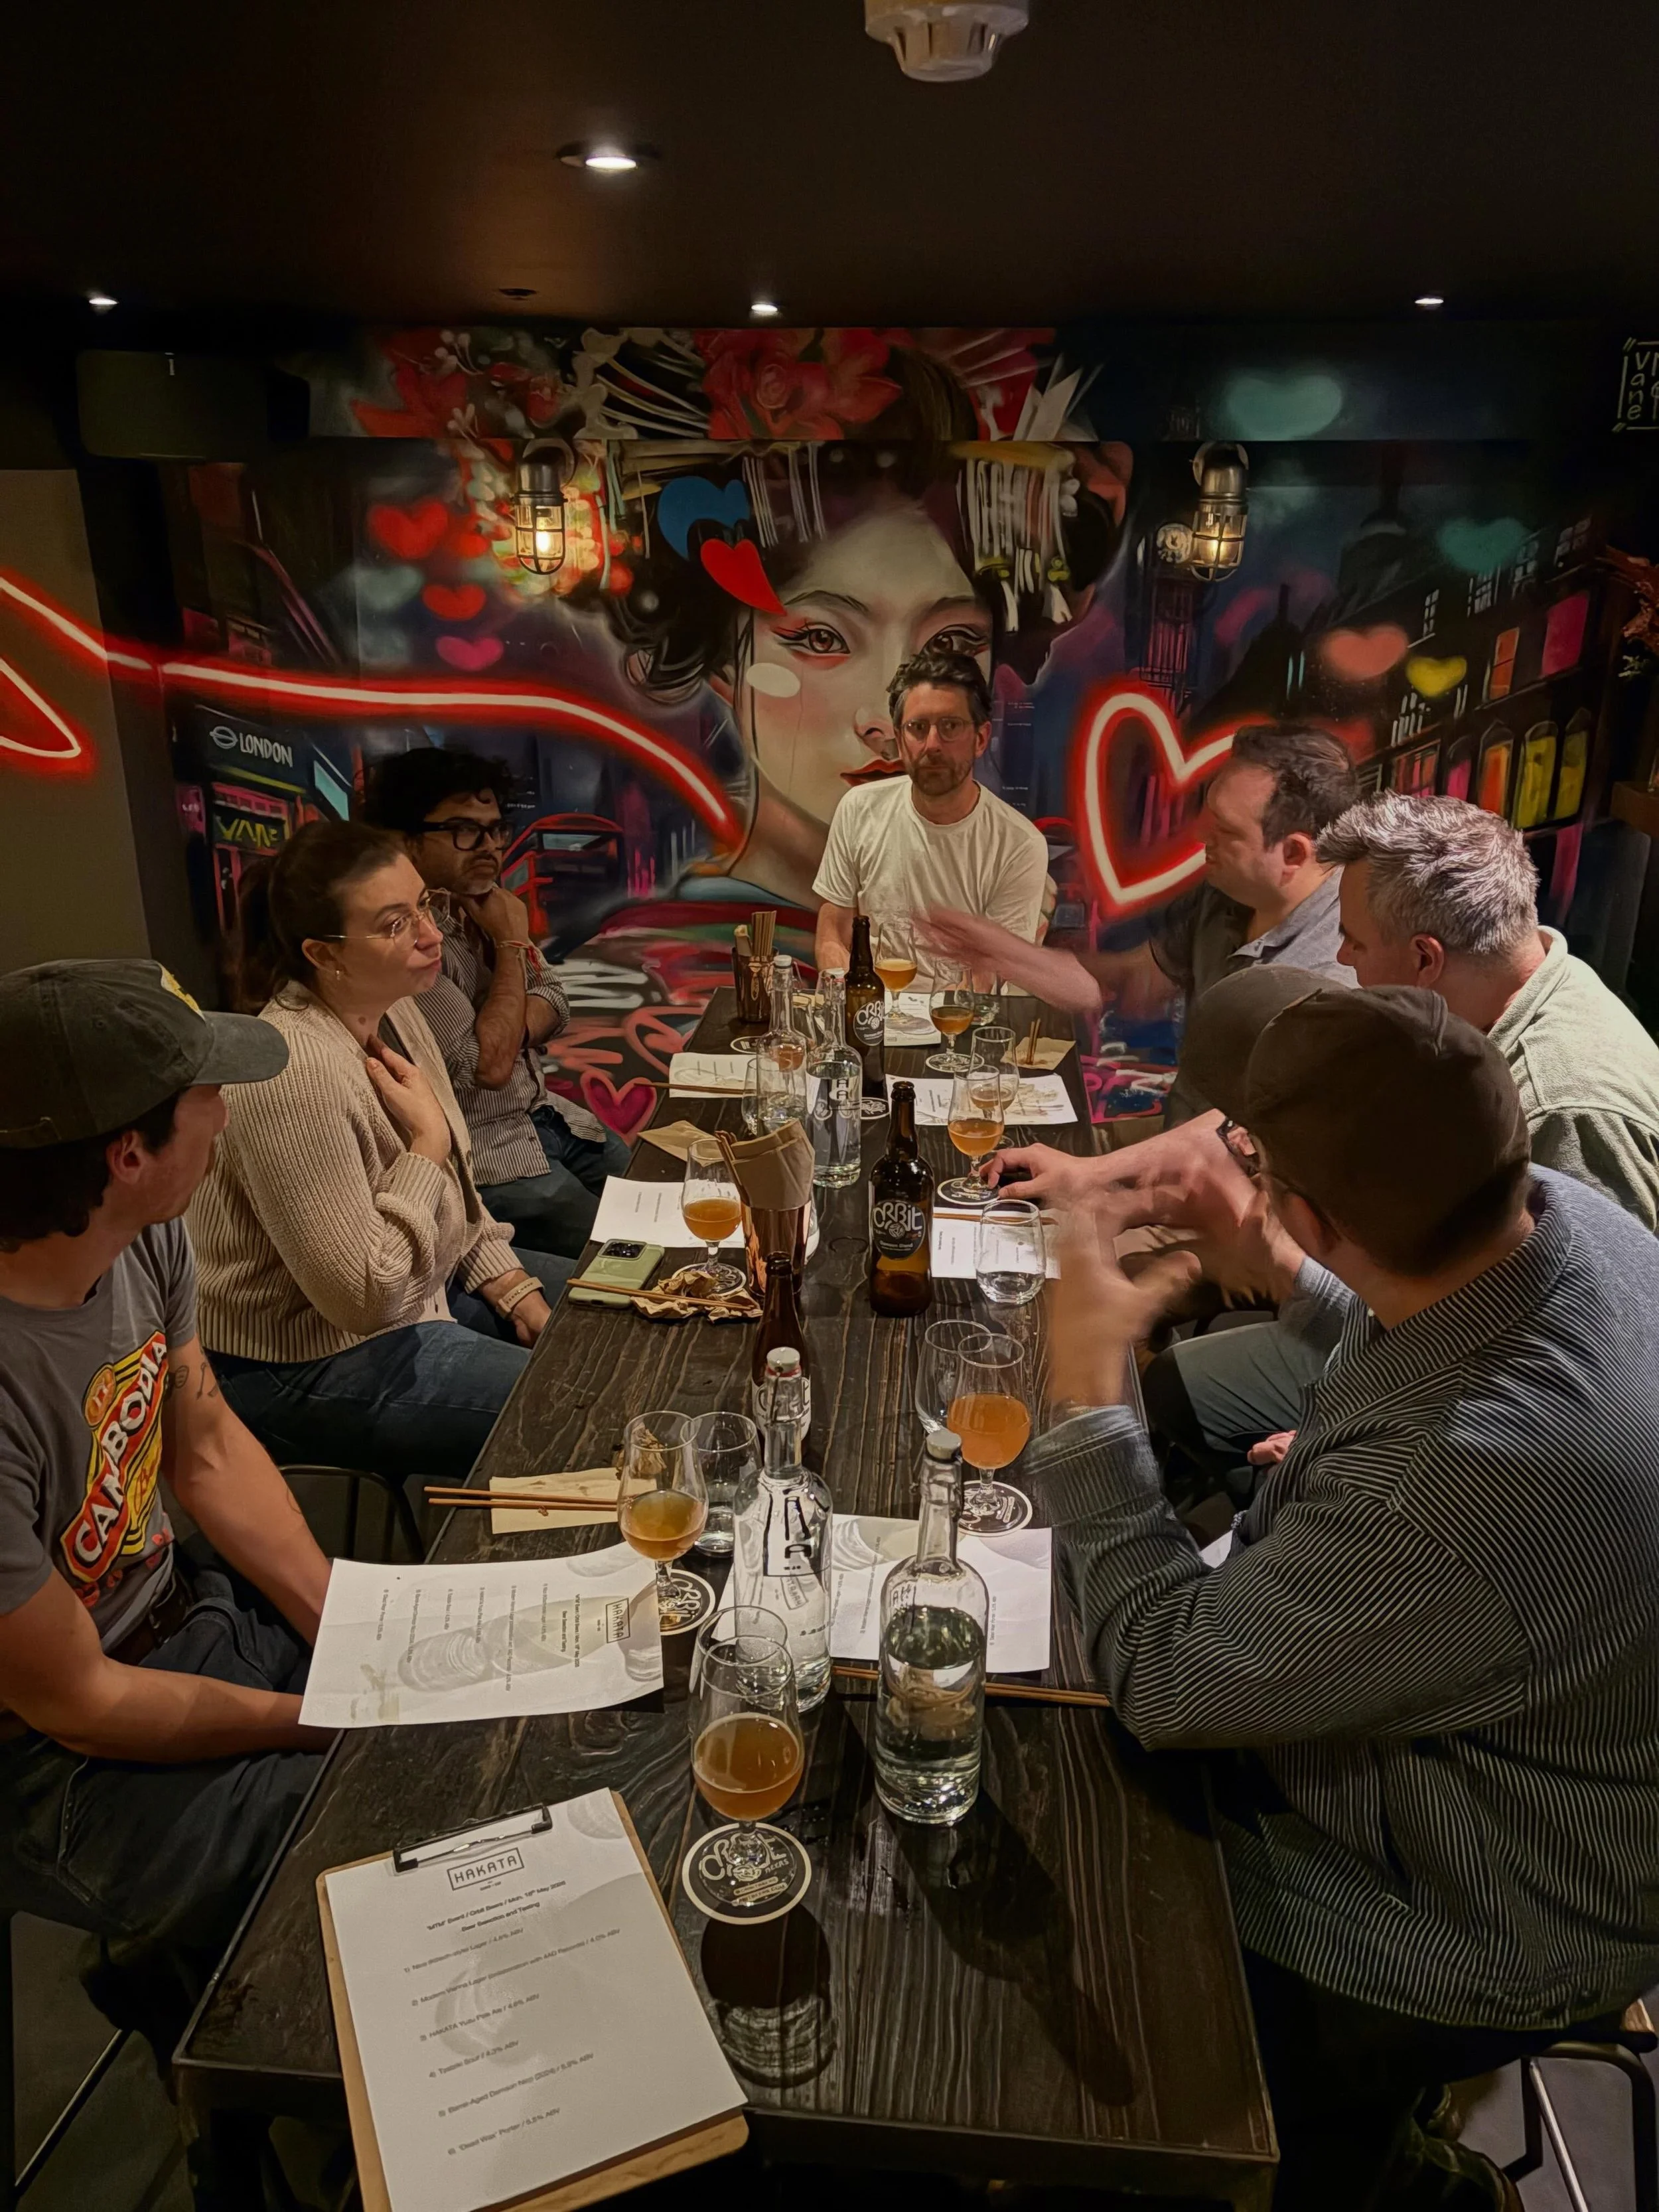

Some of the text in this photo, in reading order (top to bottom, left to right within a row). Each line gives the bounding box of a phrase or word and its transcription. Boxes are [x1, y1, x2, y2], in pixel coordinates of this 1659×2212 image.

[240, 732, 293, 768] LONDON
[612, 1603, 624, 1639] HAKATA
[454, 1855, 518, 1883] HAKATA
[429, 2023, 459, 2038] HAKATA
